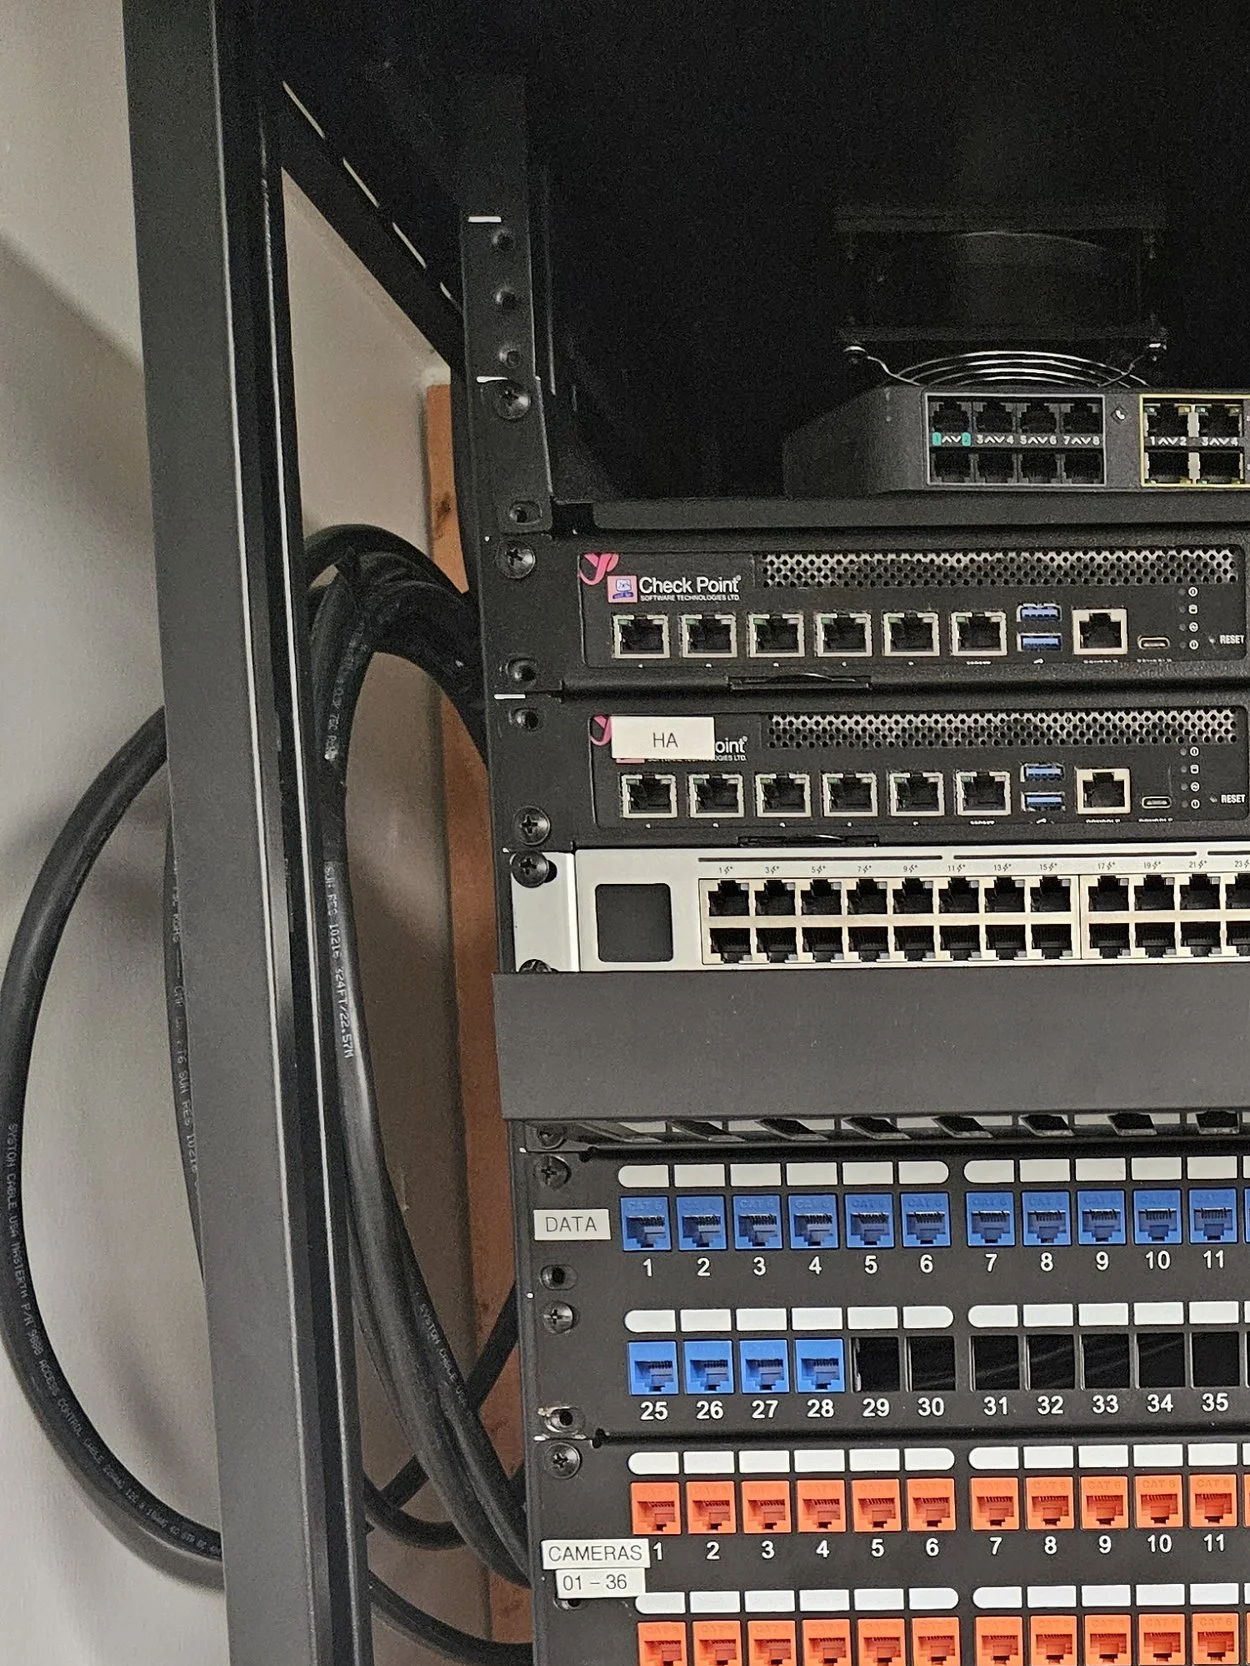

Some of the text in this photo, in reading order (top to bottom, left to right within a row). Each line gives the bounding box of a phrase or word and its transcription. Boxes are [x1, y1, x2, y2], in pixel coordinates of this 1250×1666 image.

[977, 435, 984, 445] 3
[1006, 435, 1014, 445] 4
[1020, 435, 1028, 445] 5
[1049, 435, 1057, 445] 6
[1063, 435, 1071, 445] 7
[1092, 435, 1100, 445] 8
[1178, 437, 1187, 446] 2
[1201, 437, 1209, 446] 3
[1230, 437, 1238, 446] 4
[639, 576, 693, 594] Check
[676, 594, 727, 602] TECHNOLOGIES
[1219, 634, 1245, 645] RESET
[652, 732, 679, 749] HA
[1221, 794, 1246, 804] RESET
[545, 1216, 597, 1232] DATA
[643, 1258, 652, 1277] 1
[697, 1257, 711, 1277] 2
[753, 1256, 766, 1276] 3
[808, 1256, 822, 1275] 4
[864, 1255, 878, 1274] 5
[920, 1254, 934, 1274] 6
[985, 1252, 998, 1271] 7
[1040, 1252, 1054, 1272] 8
[1096, 1251, 1109, 1271] 9
[1145, 1250, 1171, 1270] 10
[1203, 1249, 1224, 1269] 11
[640, 1401, 668, 1421] 25
[696, 1400, 724, 1420] 26
[751, 1399, 779, 1419] 27
[807, 1398, 835, 1418] 28
[862, 1397, 890, 1417] 29
[917, 1397, 945, 1417] 30
[983, 1396, 1008, 1416] 31
[1037, 1395, 1064, 1415] 32
[1092, 1394, 1119, 1414] 33
[1147, 1393, 1174, 1413] 34
[1202, 1392, 1229, 1412] 35
[548, 1545, 642, 1561] CAMERAS
[653, 1541, 663, 1560] 1
[706, 1541, 720, 1560] 2
[761, 1540, 775, 1559] 3
[815, 1539, 830, 1558] 4
[871, 1538, 885, 1557] 5
[925, 1537, 939, 1557] 6
[989, 1536, 1003, 1555] 7
[1044, 1535, 1057, 1555] 8
[1098, 1535, 1112, 1554] 9
[1147, 1533, 1172, 1553] 10
[1203, 1533, 1224, 1552] 11
[563, 1575, 581, 1591] 01
[606, 1574, 627, 1590] 36
